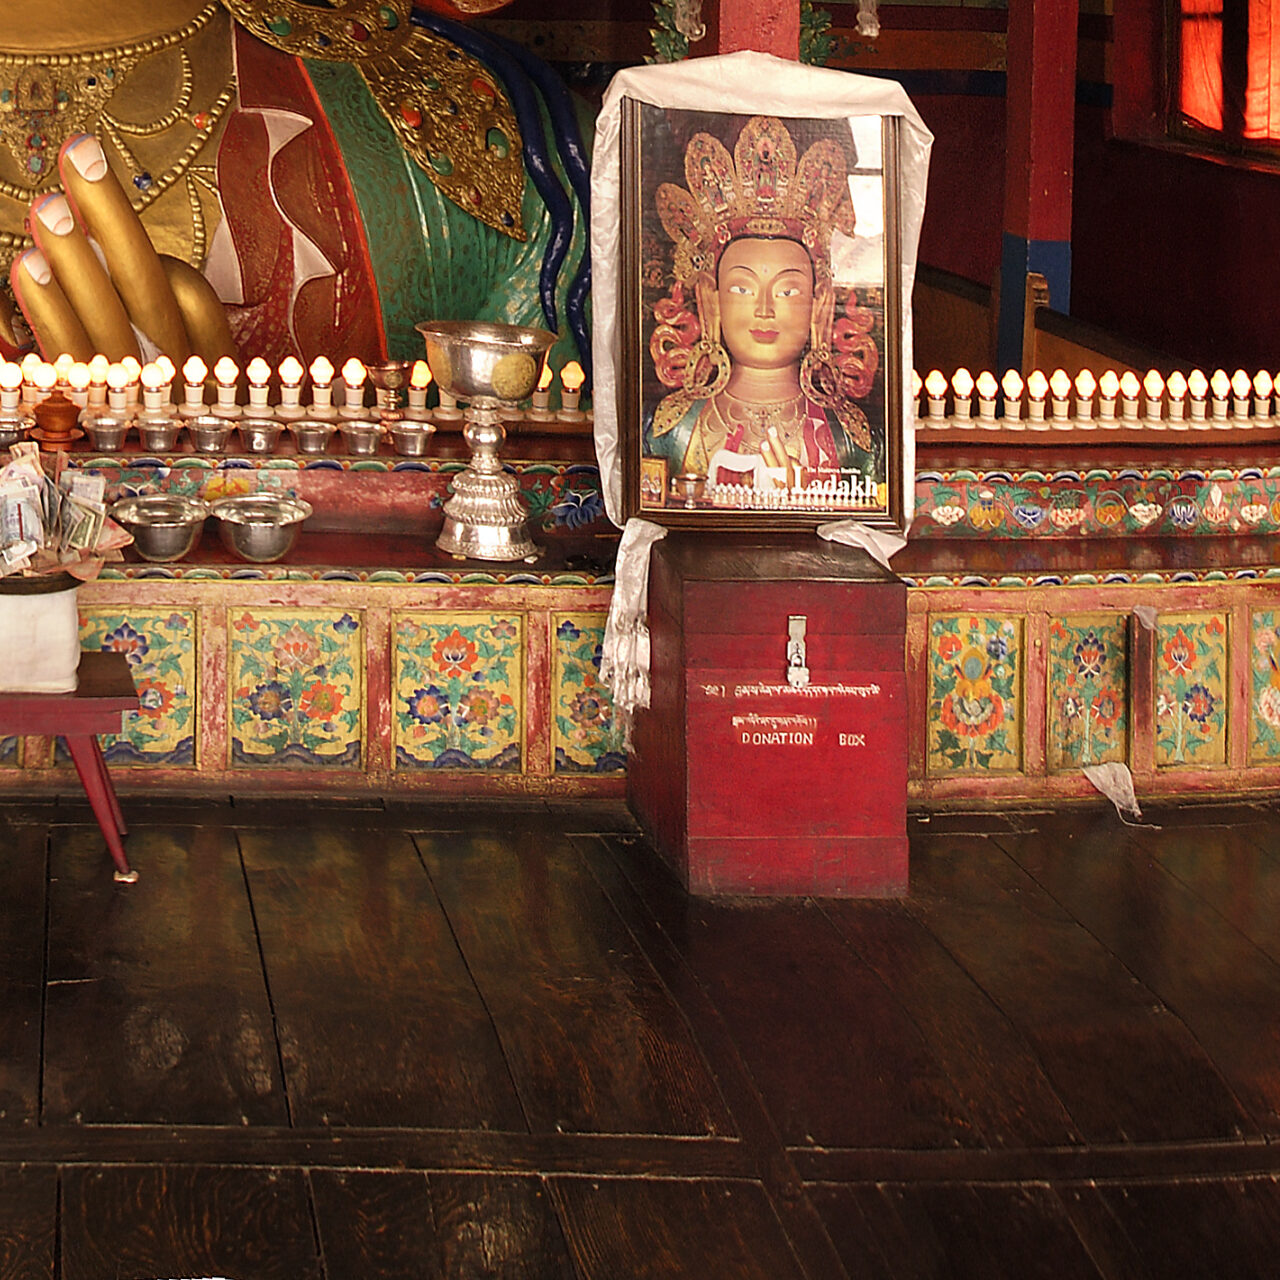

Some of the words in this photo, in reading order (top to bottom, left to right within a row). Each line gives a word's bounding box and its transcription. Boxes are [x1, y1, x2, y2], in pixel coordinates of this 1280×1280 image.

[791, 466, 878, 497] Ladakh
[742, 732, 813, 745] DONATION
[838, 733, 866, 746] BOX
